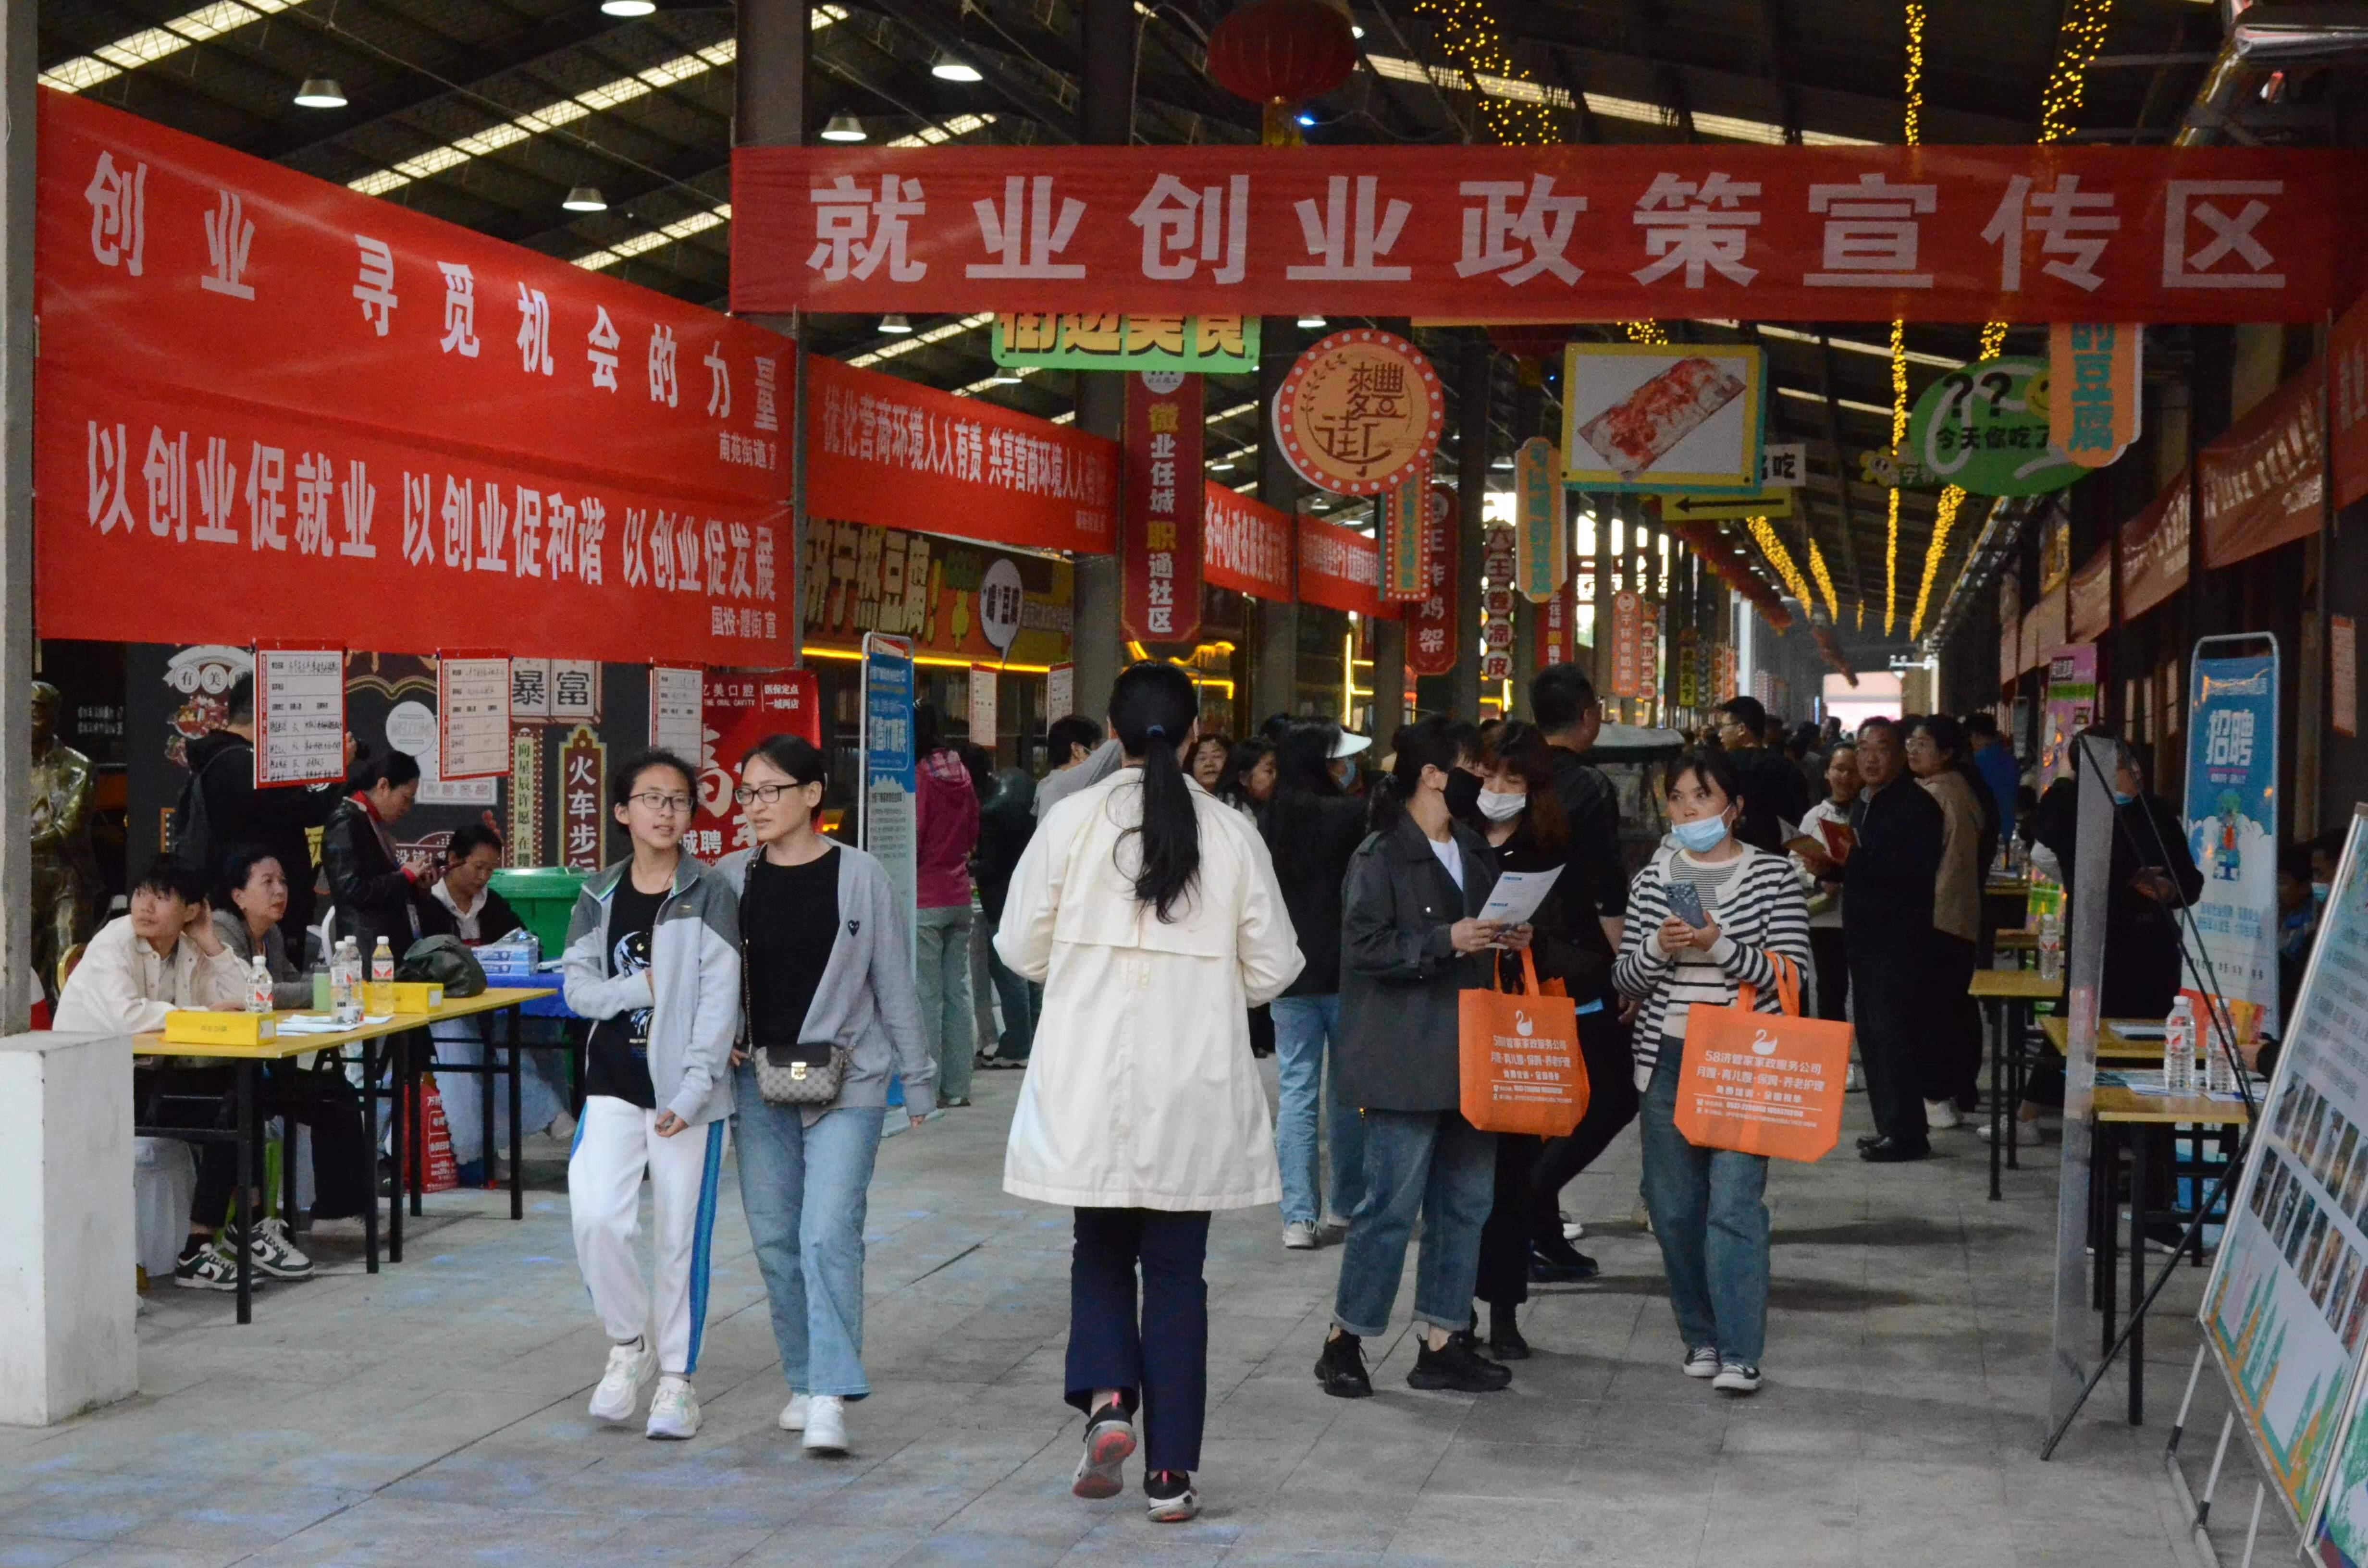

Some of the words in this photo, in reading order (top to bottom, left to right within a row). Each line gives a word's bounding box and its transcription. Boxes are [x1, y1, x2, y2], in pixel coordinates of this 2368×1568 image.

[806, 173, 2286, 292] 就业创业政策宣传区
[353, 234, 778, 431] 寻觅机会的力量
[88, 420, 376, 558] 以创业促就业
[403, 471, 605, 586] 以创业促和谐
[623, 508, 776, 602] 以创业促发展
[512, 670, 590, 706] 暴富
[2206, 709, 2255, 766] 招聘
